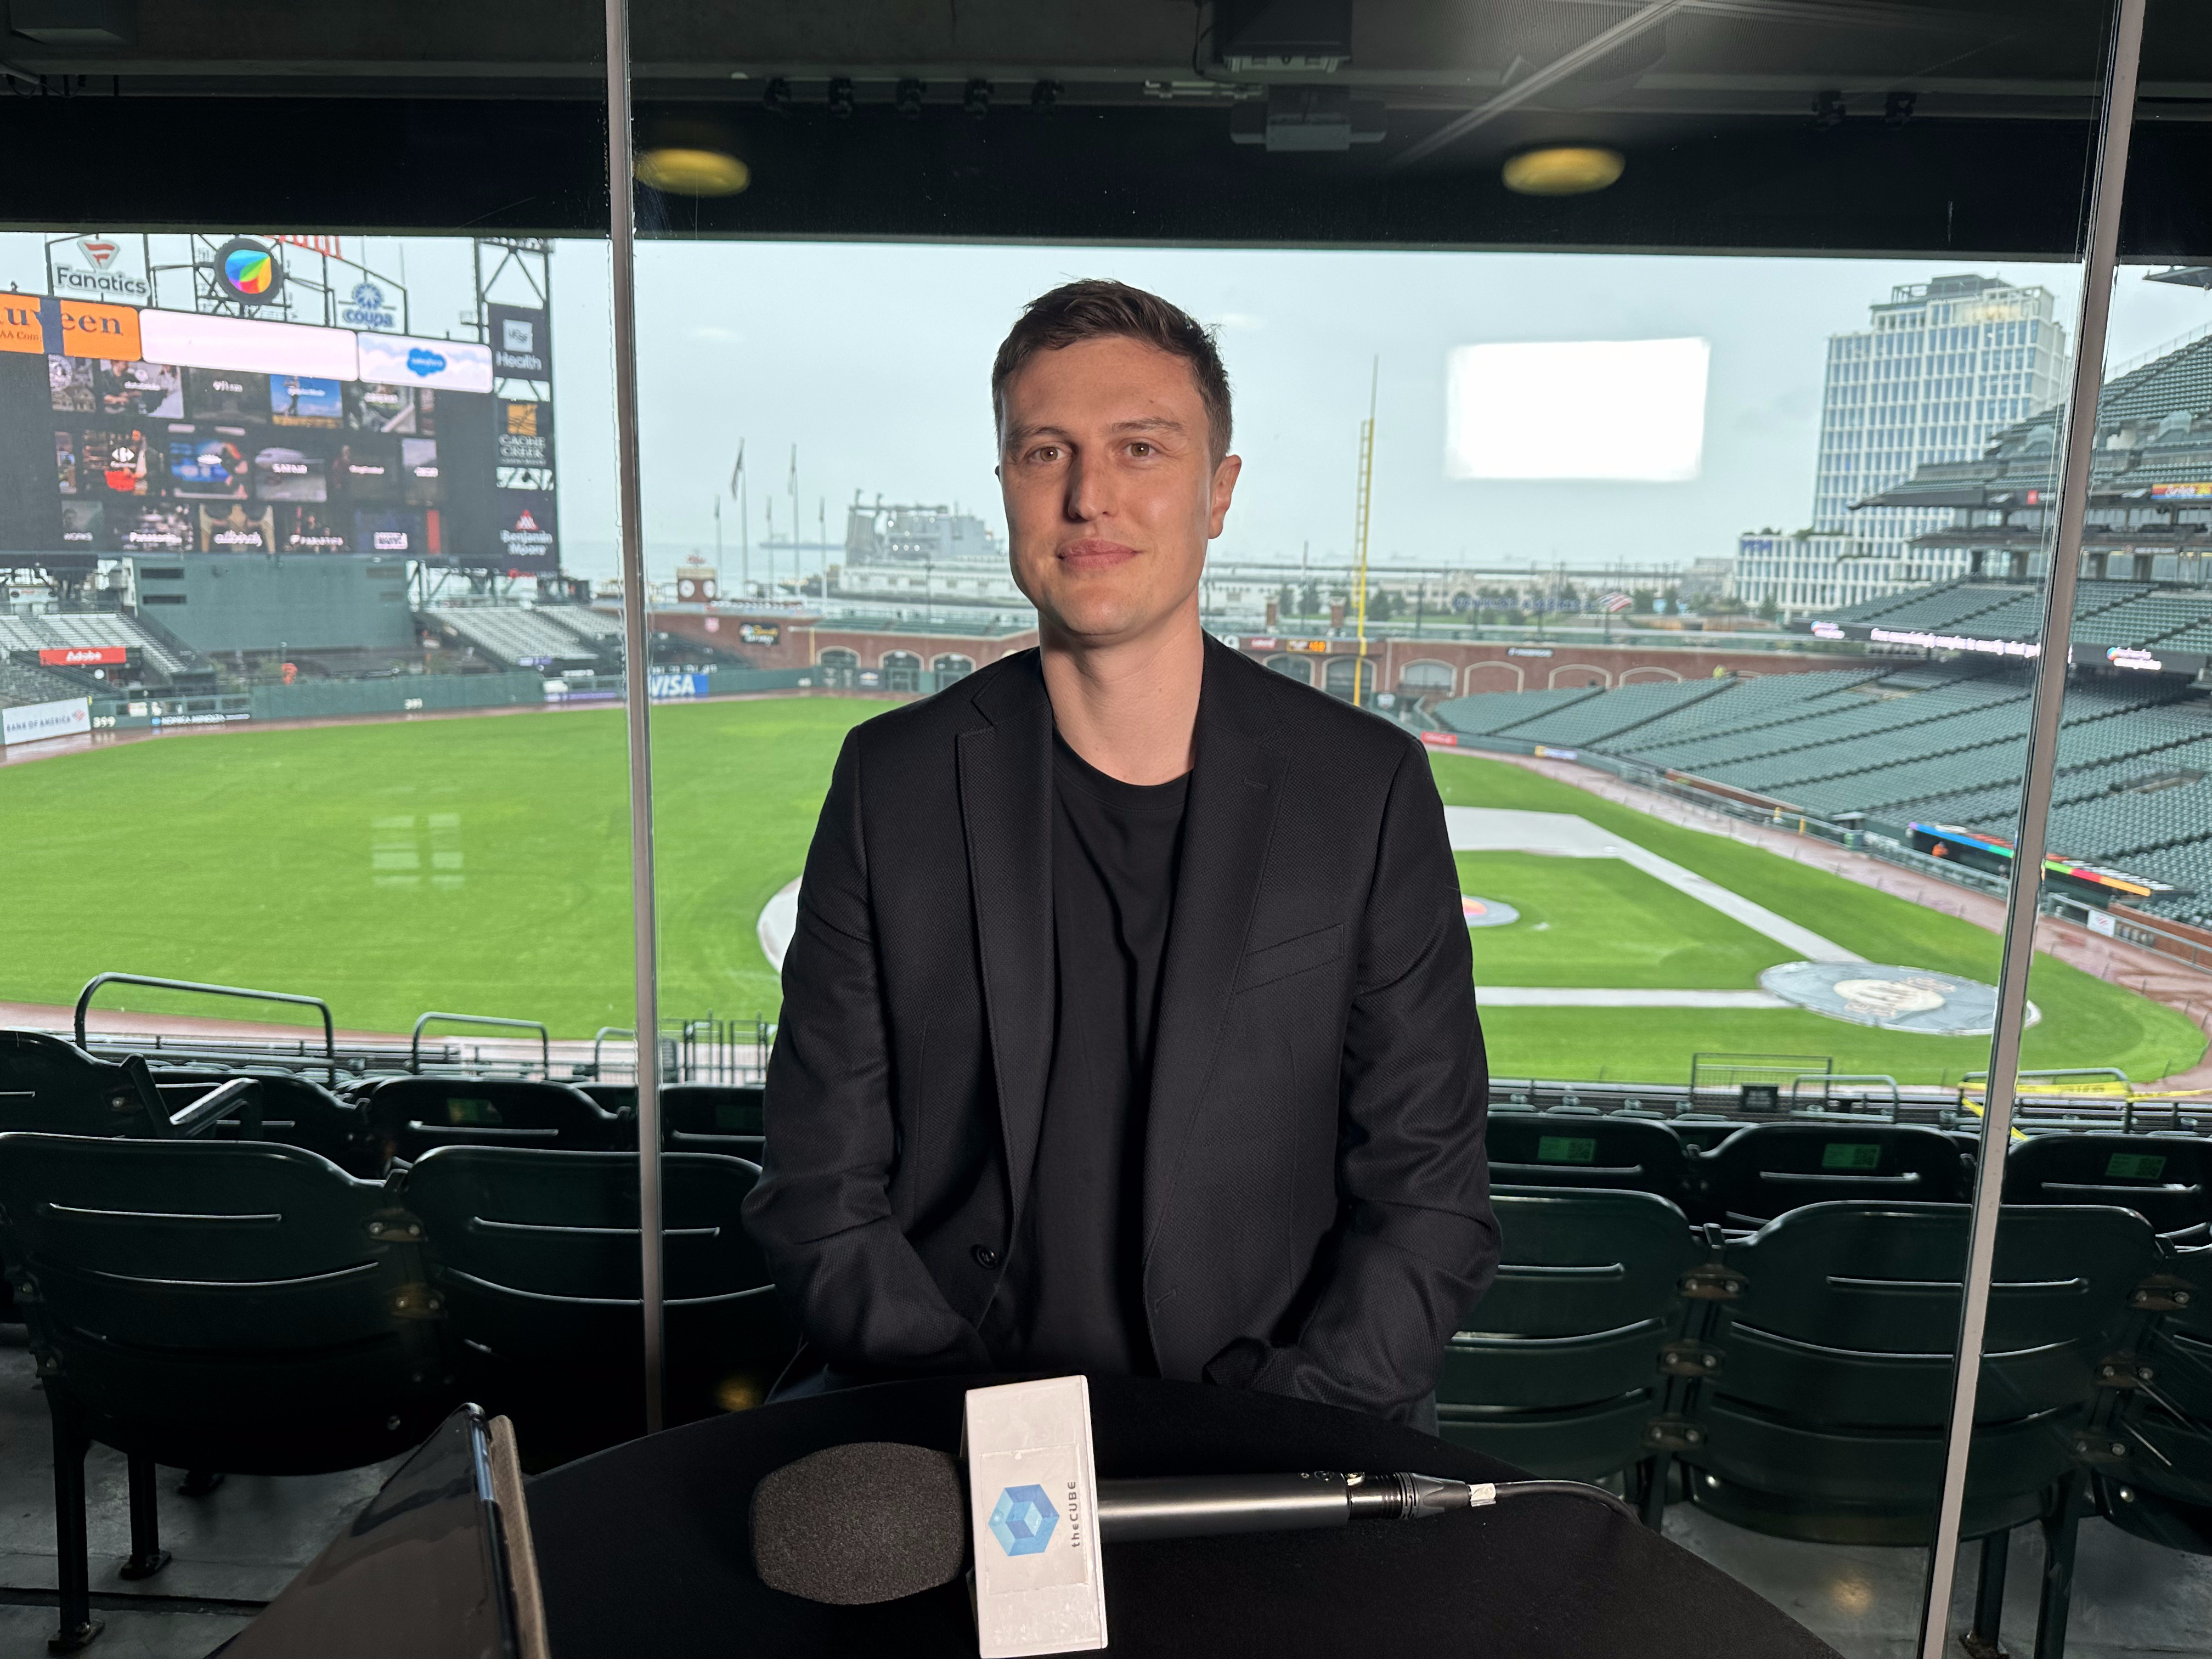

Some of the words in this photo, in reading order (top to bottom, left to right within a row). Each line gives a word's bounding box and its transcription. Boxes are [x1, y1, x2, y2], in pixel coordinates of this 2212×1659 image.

[57, 266, 147, 294] Fanatics
[16, 331, 42, 343] Com
[495, 351, 542, 370] Health
[499, 529, 554, 545] Benjamin
[507, 541, 548, 556] Moore
[65, 650, 102, 662] Adobe
[651, 674, 696, 697] VISA
[6, 721, 26, 732] BANK
[28, 720, 38, 729] OF
[40, 715, 71, 727] AMERICA
[1067, 1481, 1080, 1548] theCUBE
